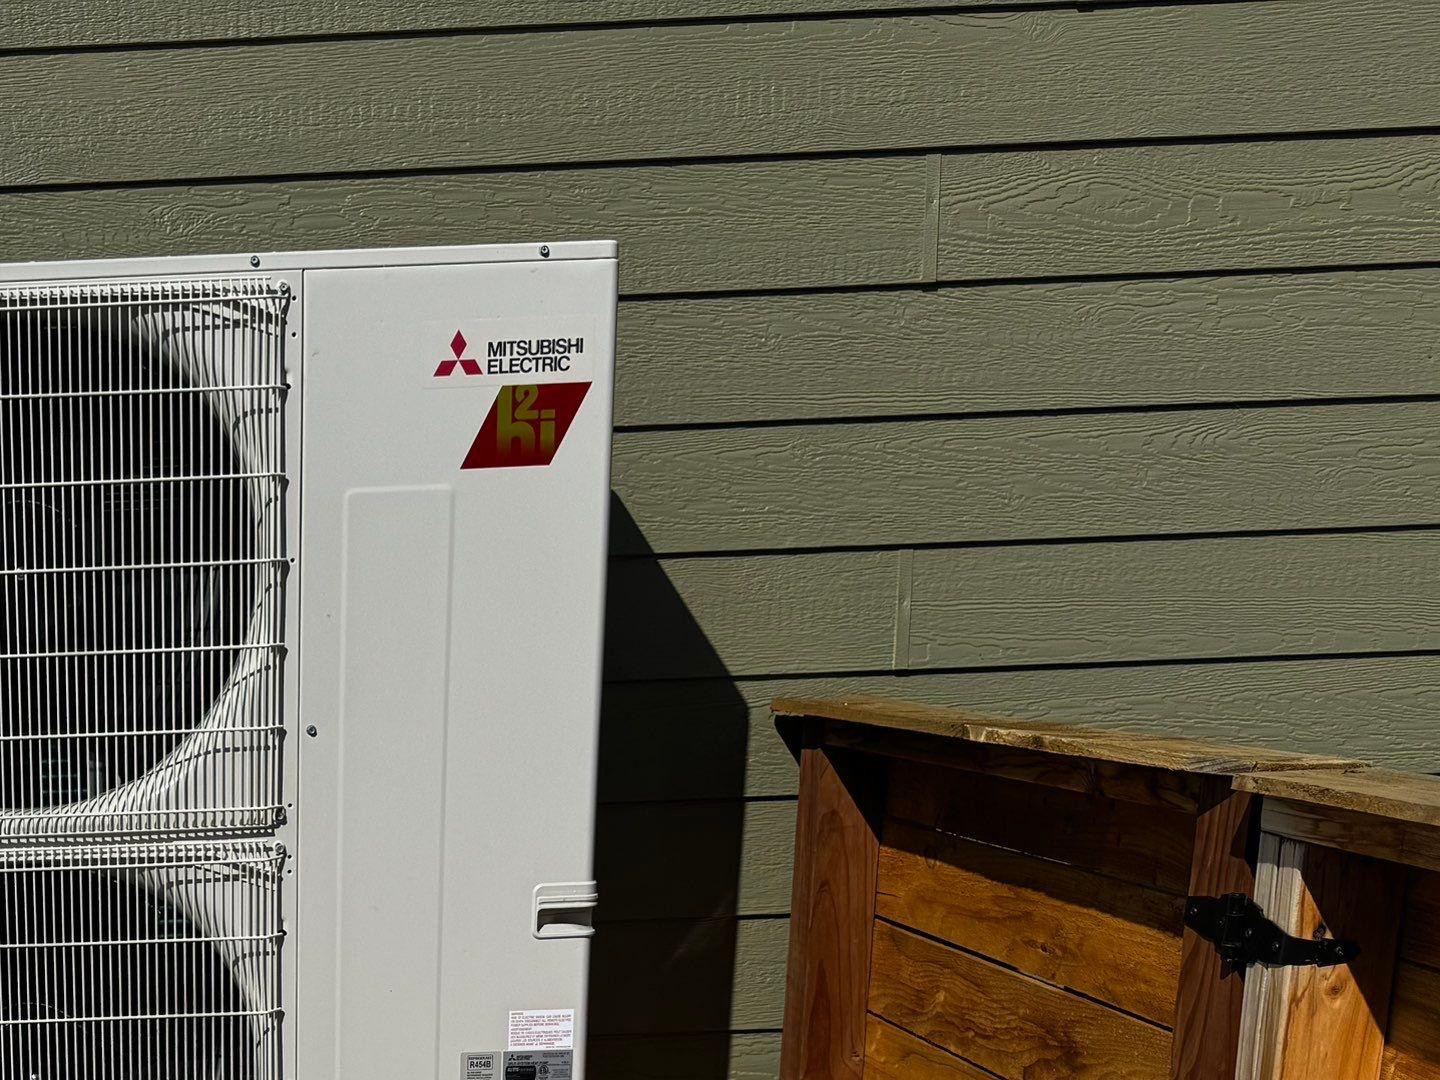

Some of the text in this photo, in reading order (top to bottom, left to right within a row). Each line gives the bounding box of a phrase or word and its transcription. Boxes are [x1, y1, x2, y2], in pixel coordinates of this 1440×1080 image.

[487, 337, 584, 358] MITSUBISHI
[487, 355, 571, 375] ELECTRIC
[469, 1060, 492, 1069] R454B
